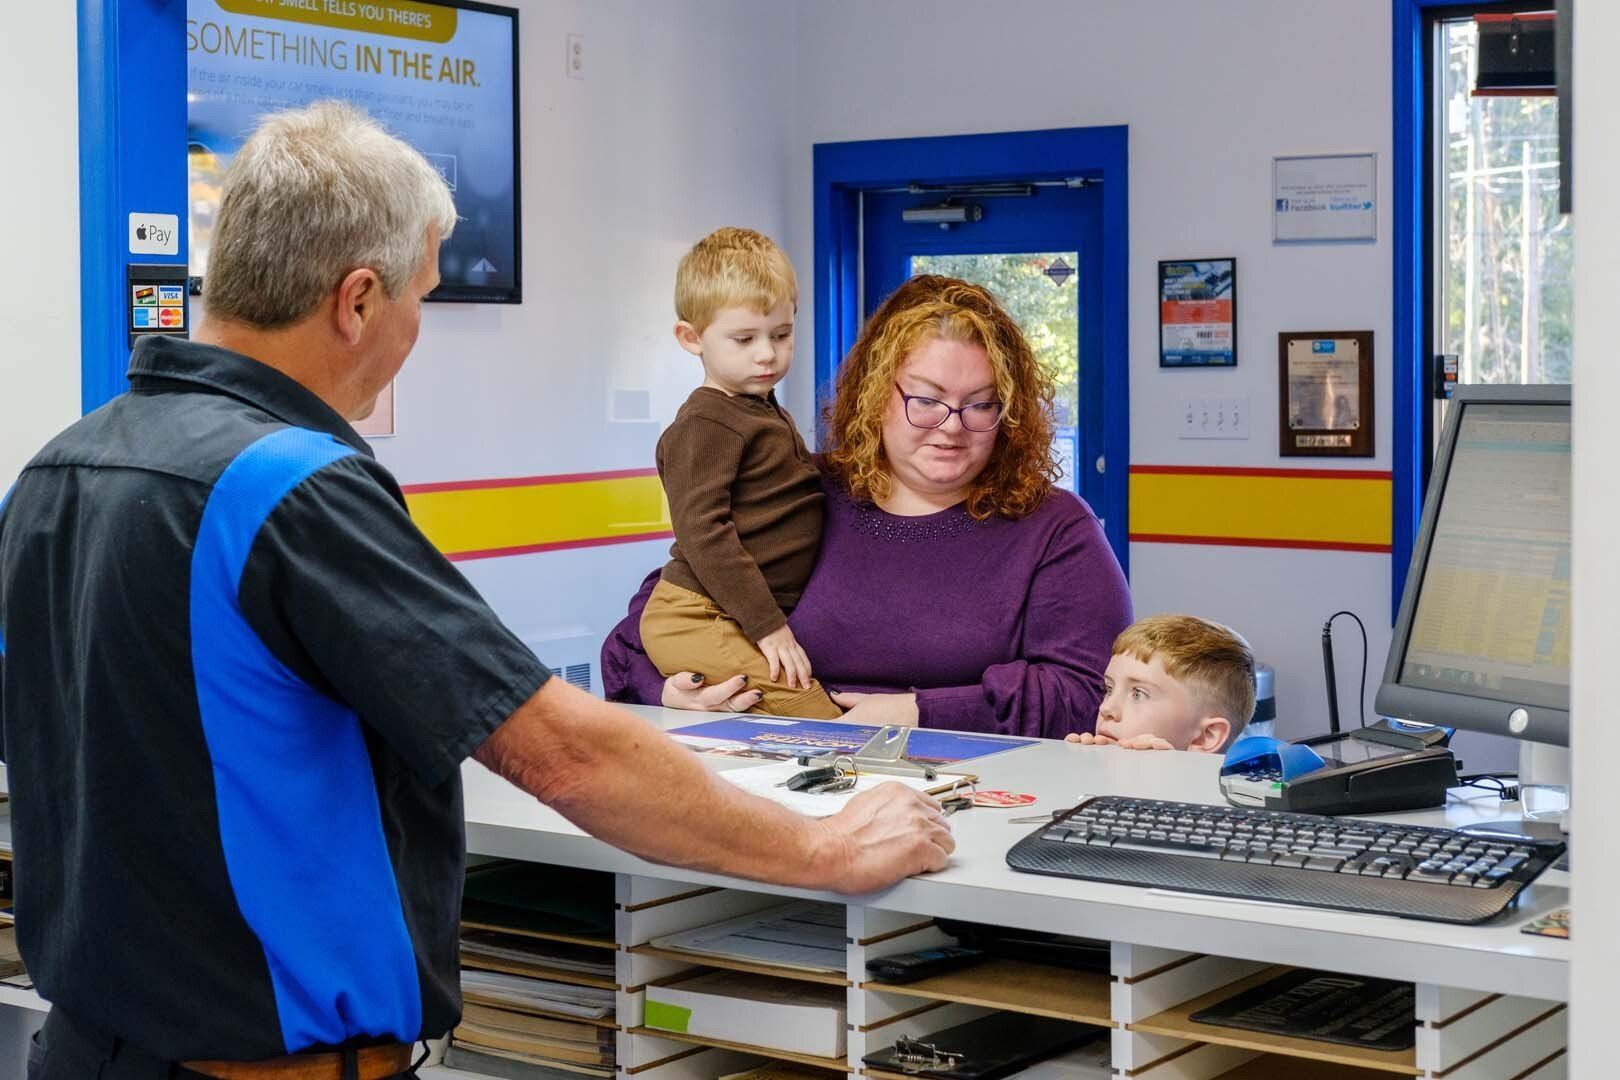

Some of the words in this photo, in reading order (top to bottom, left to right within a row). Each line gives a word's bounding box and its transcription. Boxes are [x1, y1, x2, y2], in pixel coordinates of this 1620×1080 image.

[323, 0, 356, 17] TELLS
[359, 3, 384, 21] YOU
[387, 8, 432, 29] THERE'S
[187, 19, 348, 71] SOMETHING
[355, 44, 382, 74] IN
[387, 48, 433, 80] THE
[437, 56, 480, 87] AIR.
[149, 225, 171, 246] Pay
